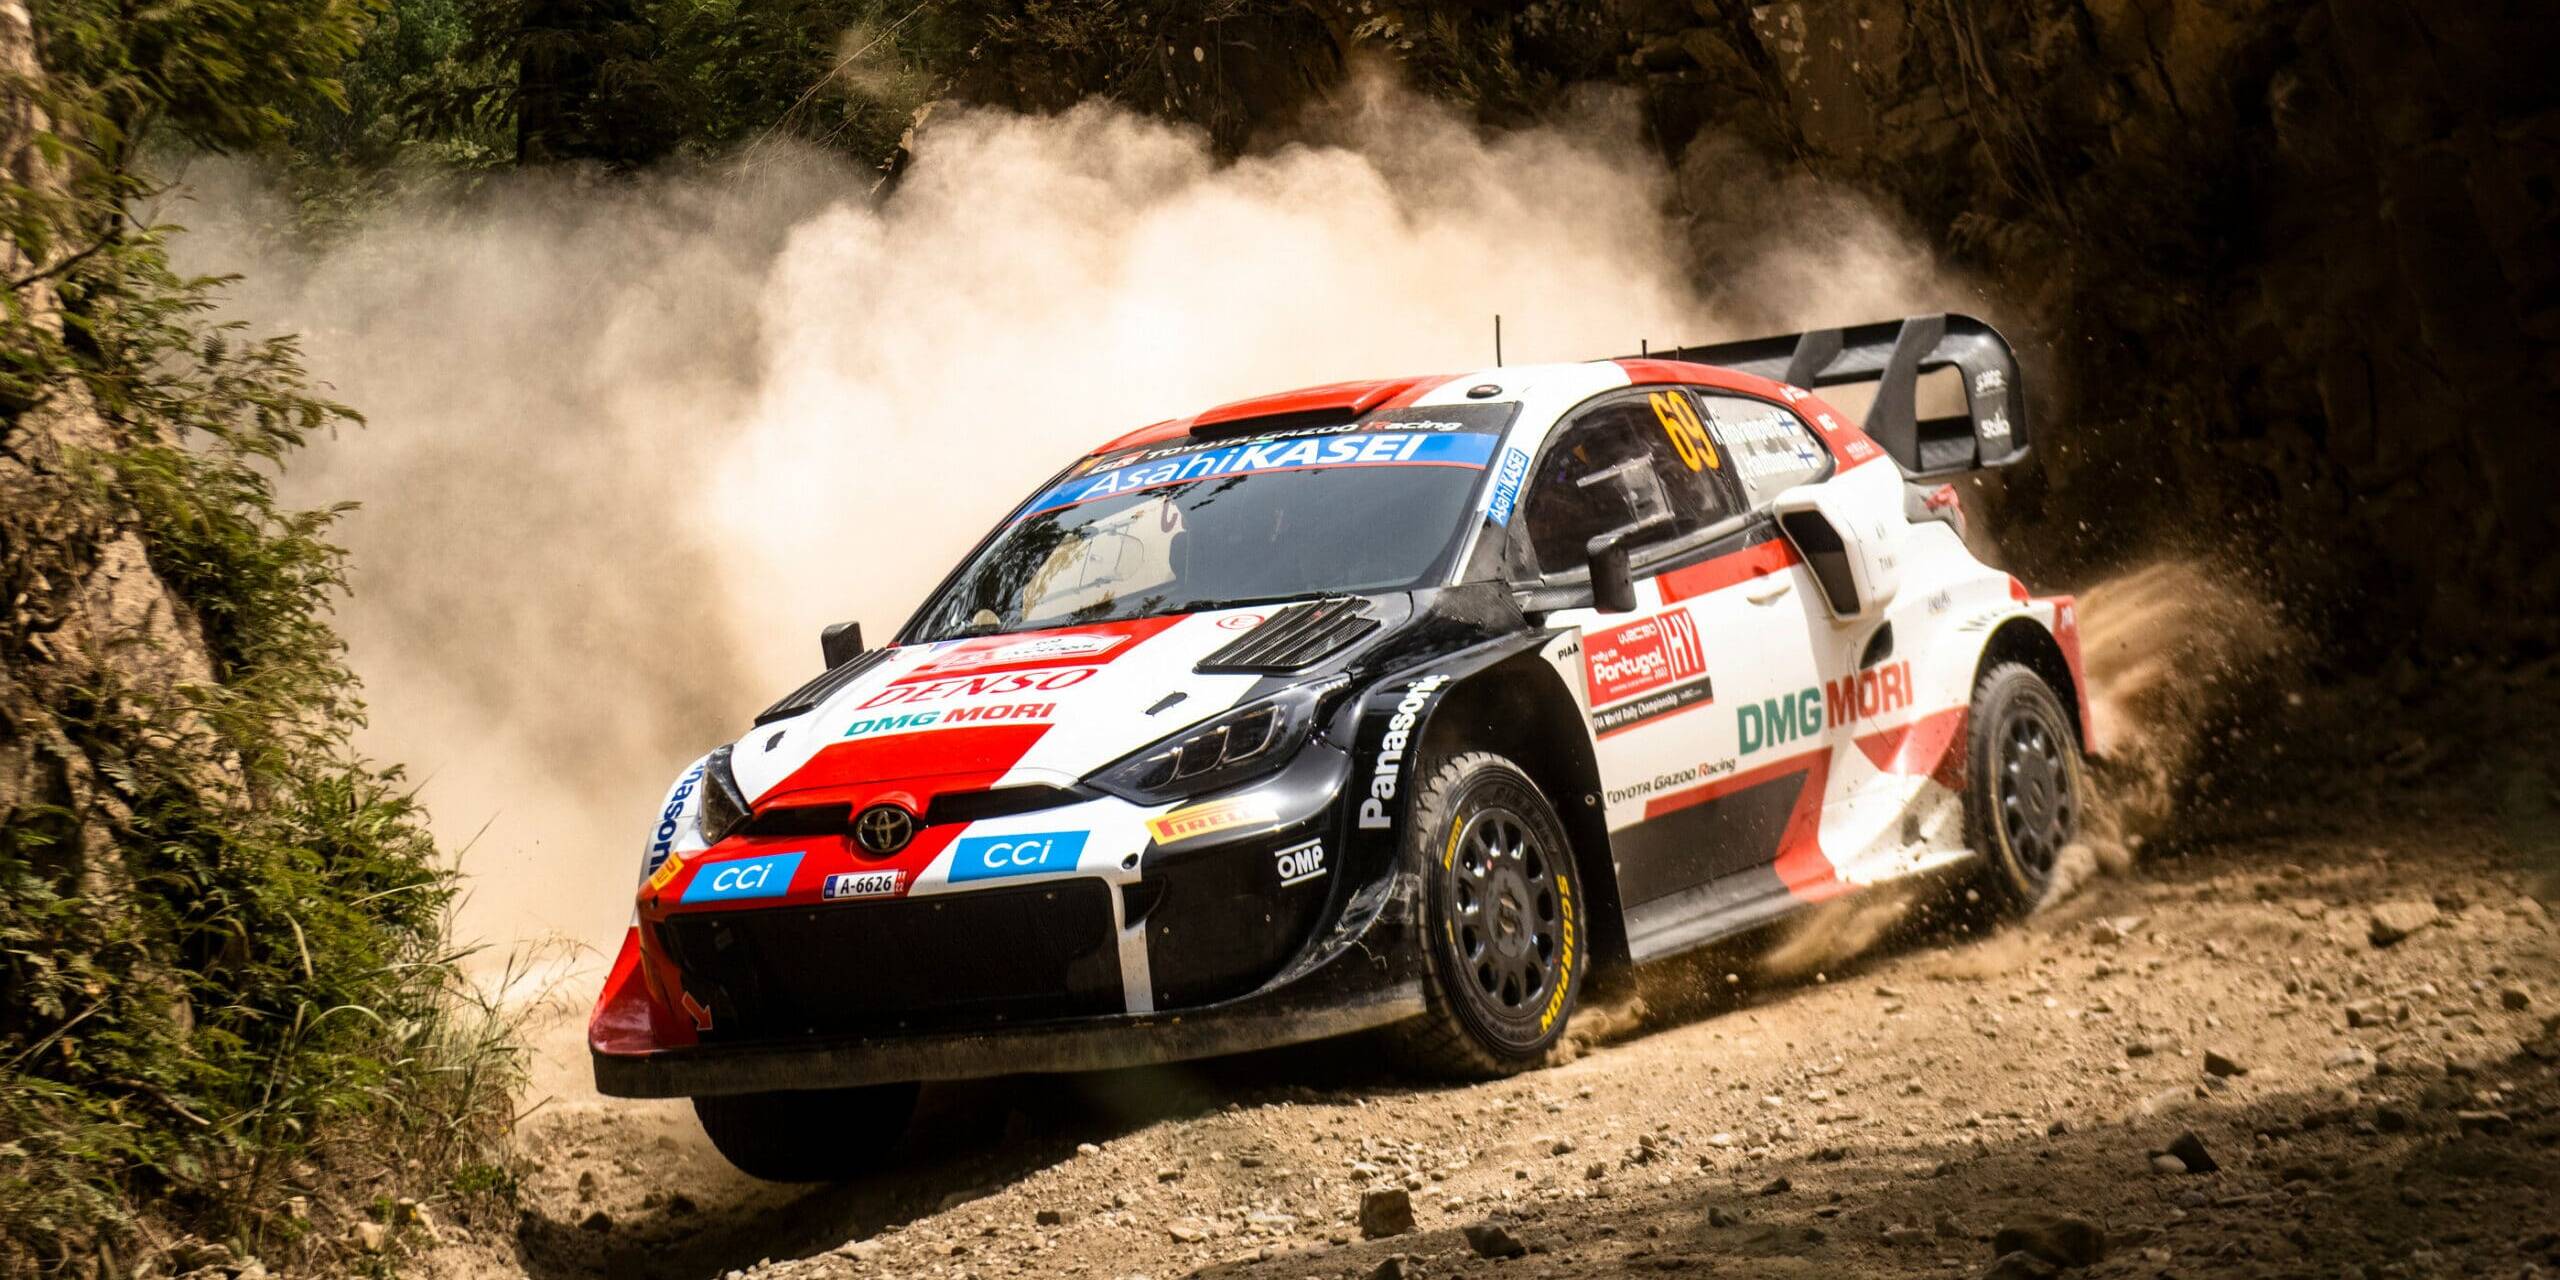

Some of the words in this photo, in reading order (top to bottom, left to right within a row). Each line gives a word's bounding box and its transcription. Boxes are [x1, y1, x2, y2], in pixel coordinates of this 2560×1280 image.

[1362, 420, 1463, 432] Racing
[1648, 390, 1720, 473] 69
[1558, 643, 1579, 661] PIAA
[1661, 611, 1700, 675] HY
[1594, 645, 1665, 685] Portugal
[855, 668, 1098, 711] DENSO
[1737, 687, 1823, 756] DMG
[1826, 661, 1913, 729] MORI
[843, 710, 937, 737] DMG
[942, 702, 1057, 723] MORI
[1606, 782, 1650, 803] TOYOTA
[1654, 768, 1696, 790] GAZOO
[1698, 758, 1736, 777] Racing
[1277, 845, 1324, 878] OMP
[840, 875, 892, 894] A-6626
[1539, 874, 1574, 1036] SCORPION
